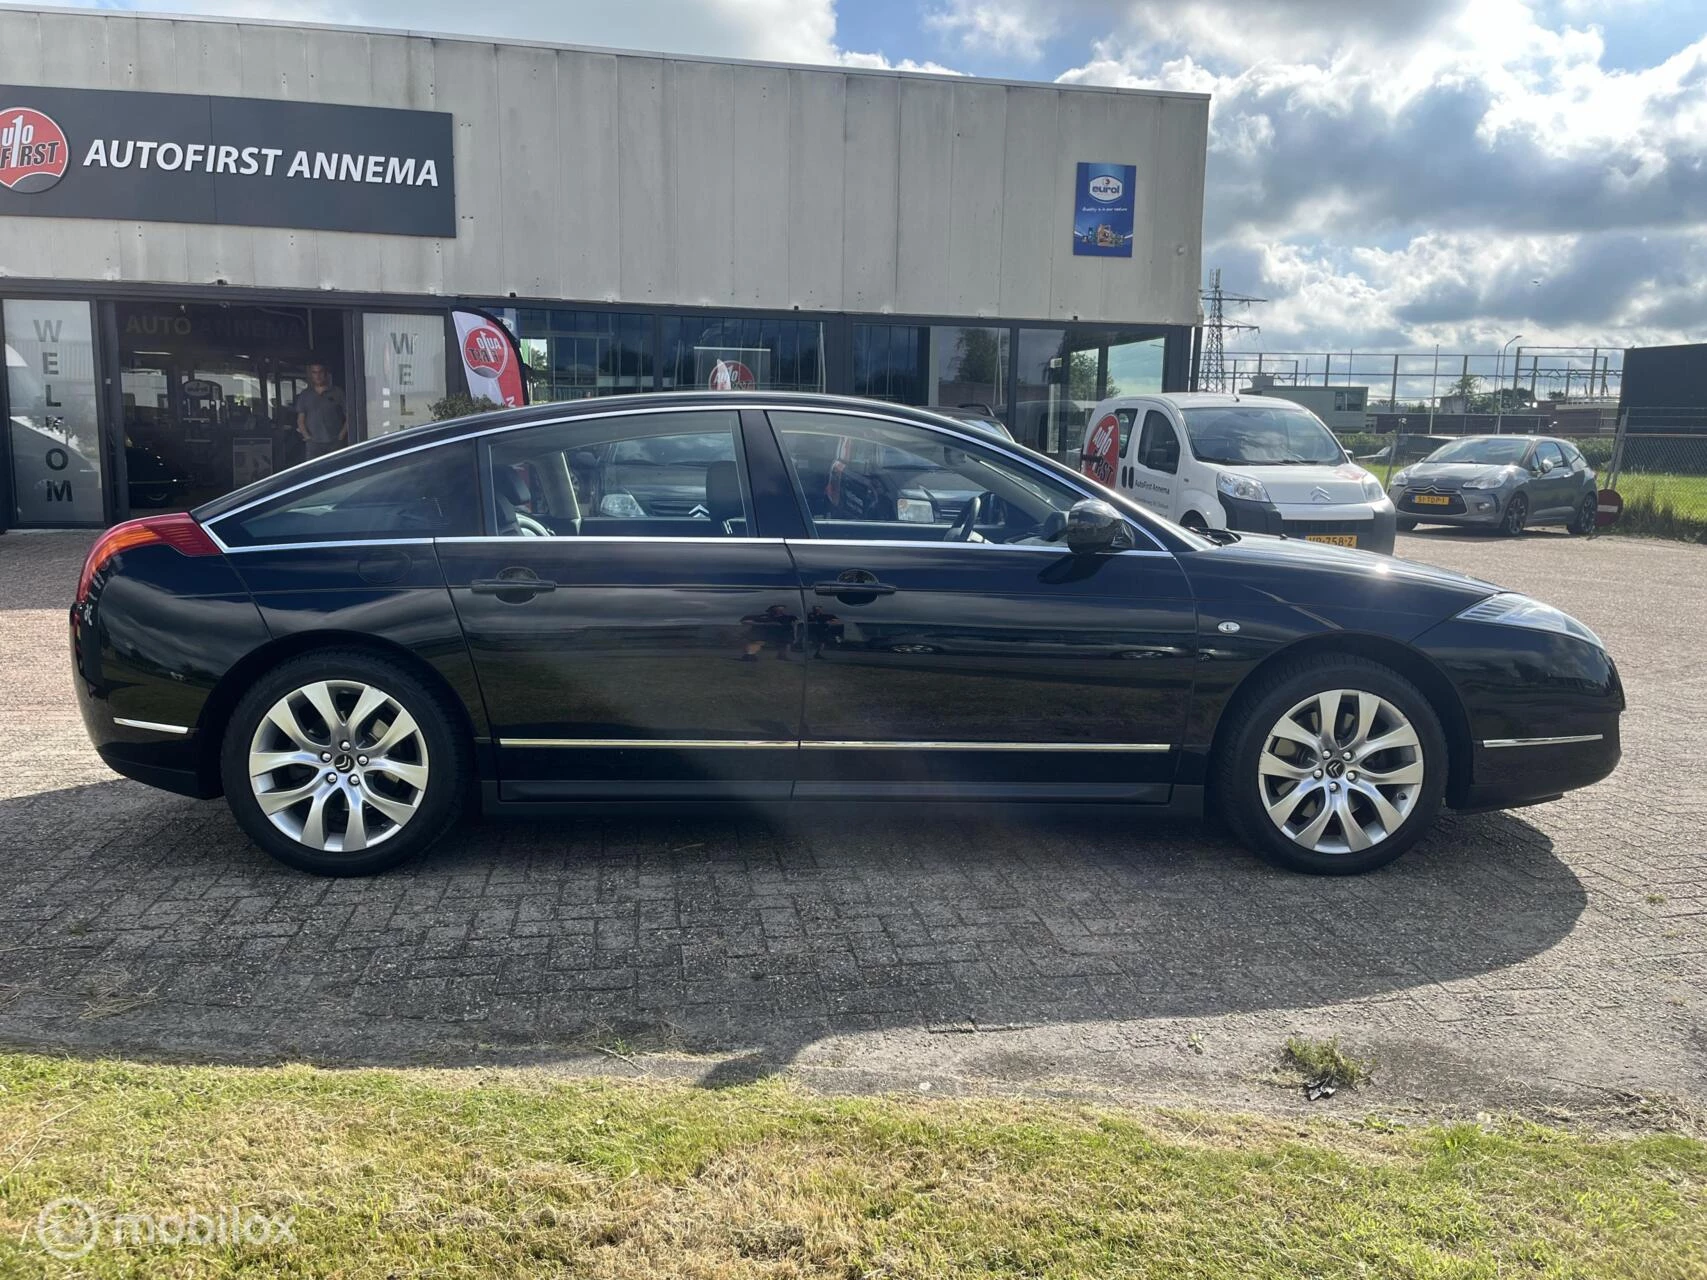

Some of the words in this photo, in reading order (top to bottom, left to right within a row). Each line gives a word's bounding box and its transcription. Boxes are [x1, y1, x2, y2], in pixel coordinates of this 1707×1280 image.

[83, 139, 282, 176] AUTOFIRST
[286, 150, 439, 187] ANNEMA
[1092, 185, 1120, 194] eurol
[126, 315, 192, 336] AUTO
[390, 332, 418, 430] WEL
